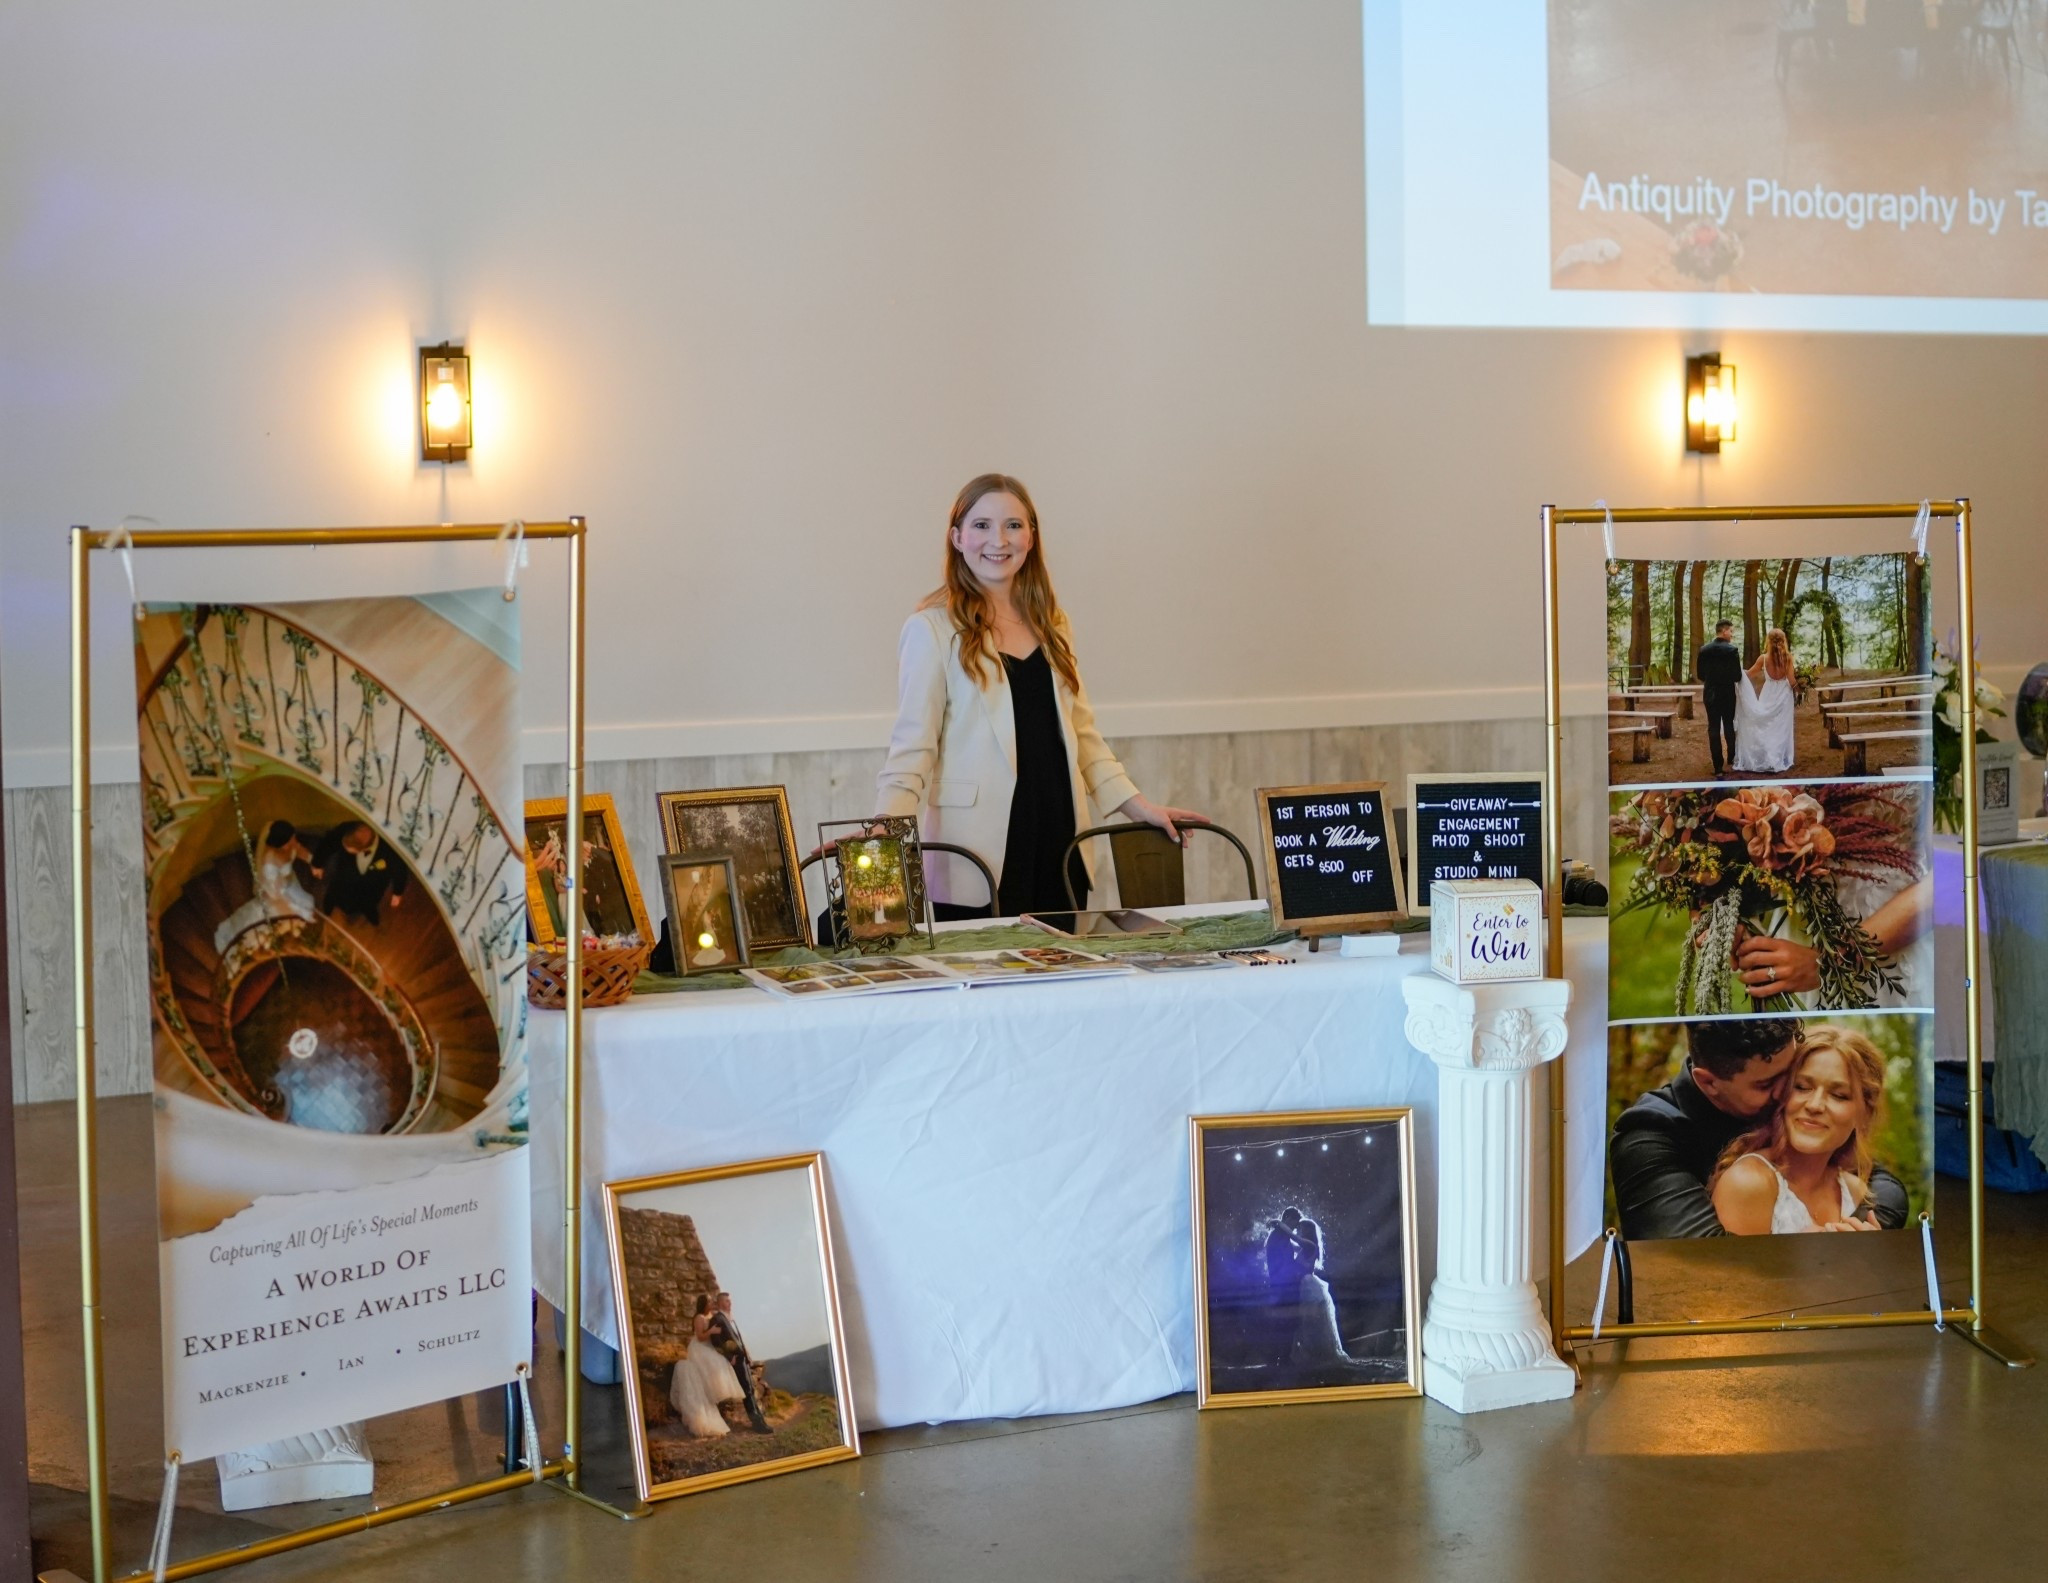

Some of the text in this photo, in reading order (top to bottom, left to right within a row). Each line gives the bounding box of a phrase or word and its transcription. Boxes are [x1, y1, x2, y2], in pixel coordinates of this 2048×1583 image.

[1578, 171, 1735, 225] Antiquity
[1746, 178, 1957, 233] Photography
[1967, 187, 2006, 235] by
[1276, 801, 1372, 820] 1ST PERSON TO
[1450, 798, 1508, 811] GIVEAWAY
[1438, 817, 1520, 831] ENGAGEMENT
[1274, 825, 1380, 851] BOOK A Wedding
[1432, 833, 1525, 847] PHOTO SHOOT
[1284, 854, 1344, 873] GETS $500
[1473, 851, 1482, 862] &
[1352, 870, 1373, 883] OFF
[1435, 866, 1517, 879] STUDIO MINI
[1473, 912, 1529, 931] Enter to
[1471, 931, 1531, 964] Win
[209, 1198, 479, 1266] Capturing All Of Life's Special Moments
[265, 1279, 285, 1299] A
[458, 1267, 507, 1297] LLC
